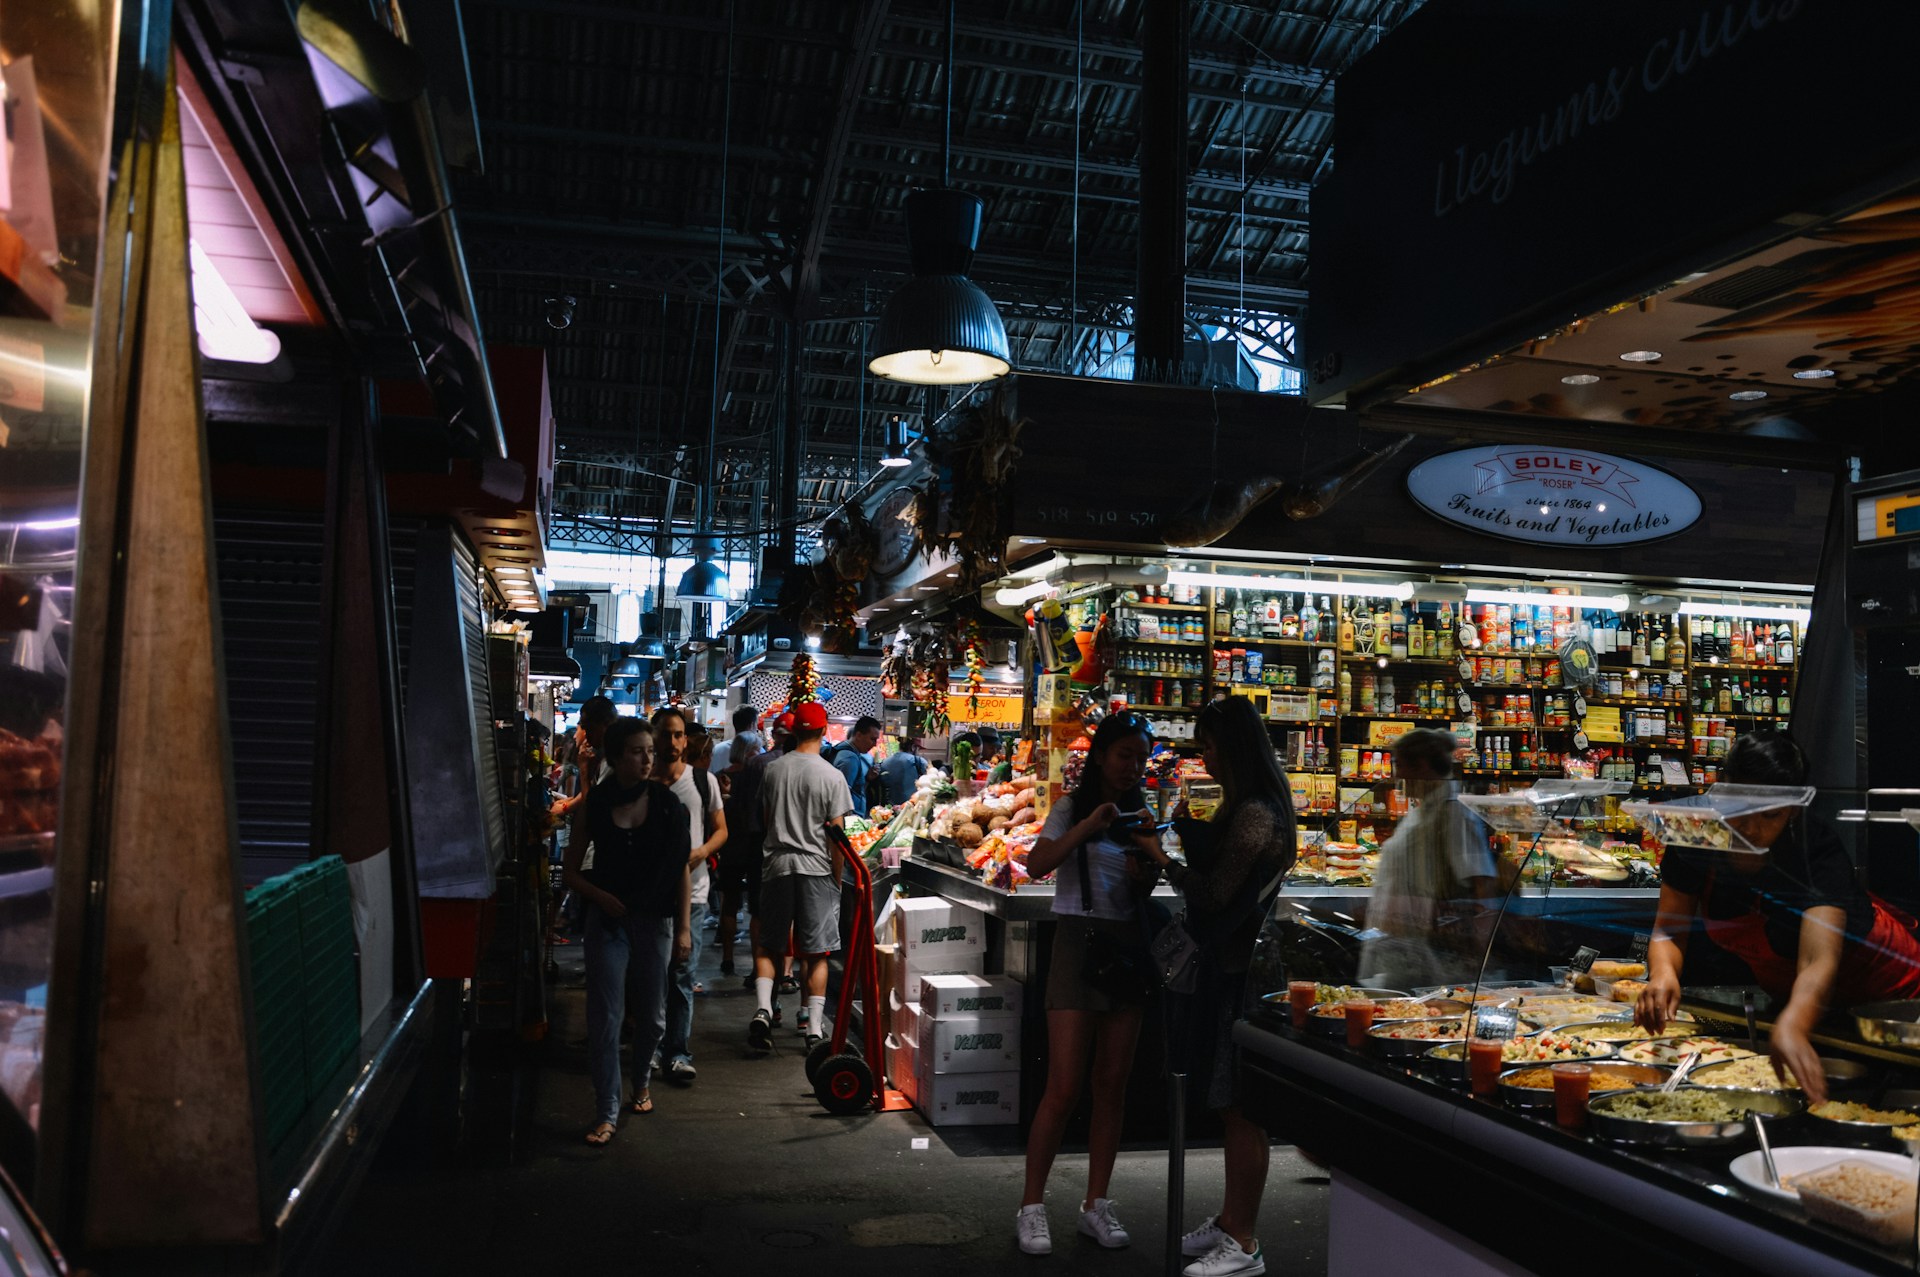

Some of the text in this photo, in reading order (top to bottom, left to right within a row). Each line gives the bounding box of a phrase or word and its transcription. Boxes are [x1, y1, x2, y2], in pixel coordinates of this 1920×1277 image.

[1434, 64, 1635, 217] Llegums
[1312, 352, 1336, 385] 549
[1514, 456, 1602, 476] SOLEY
[1526, 497, 1593, 511] since 1864
[1447, 492, 1671, 543] Fruits and Vegetables
[964, 699, 1006, 708] SFFRON
